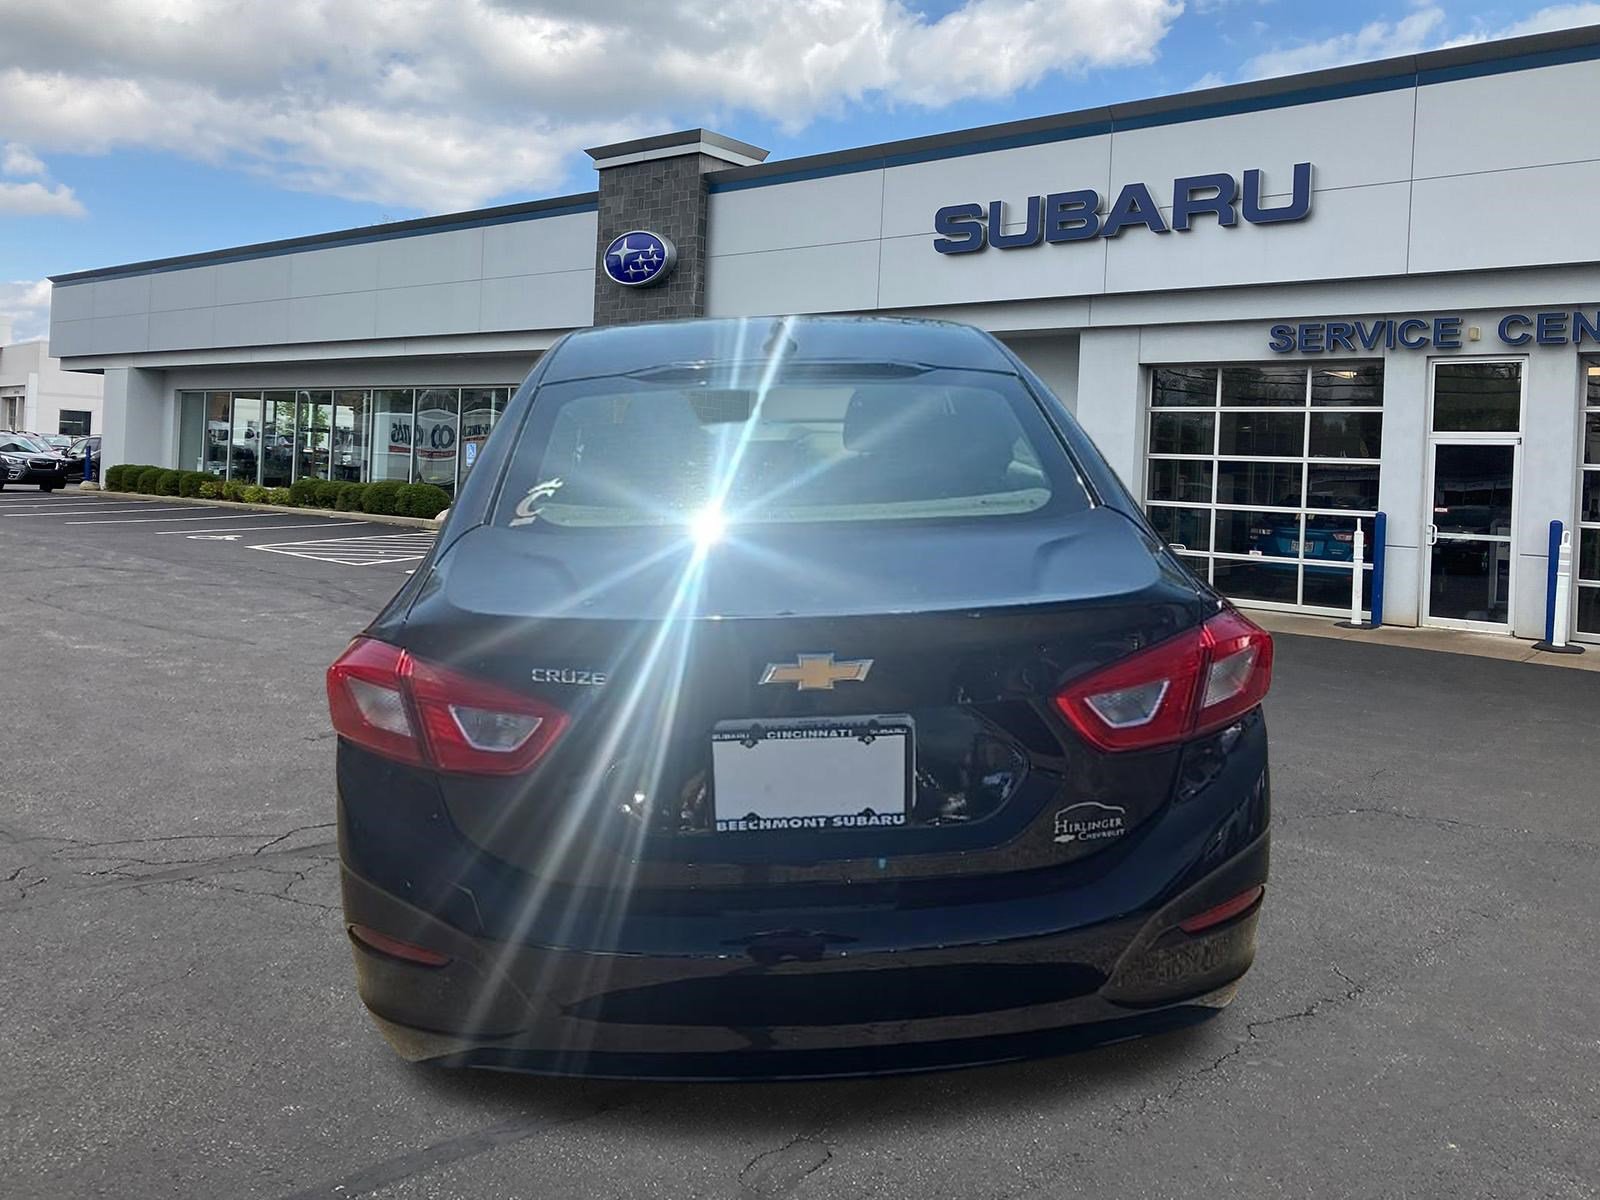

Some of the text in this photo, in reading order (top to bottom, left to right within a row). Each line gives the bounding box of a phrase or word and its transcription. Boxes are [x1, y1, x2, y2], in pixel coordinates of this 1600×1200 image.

[933, 161, 1315, 256] SUBARU
[1268, 316, 1464, 354] SERVICE
[766, 729, 853, 739] CINCINNATI
[716, 813, 907, 832] BEECHMONT SUBARU
